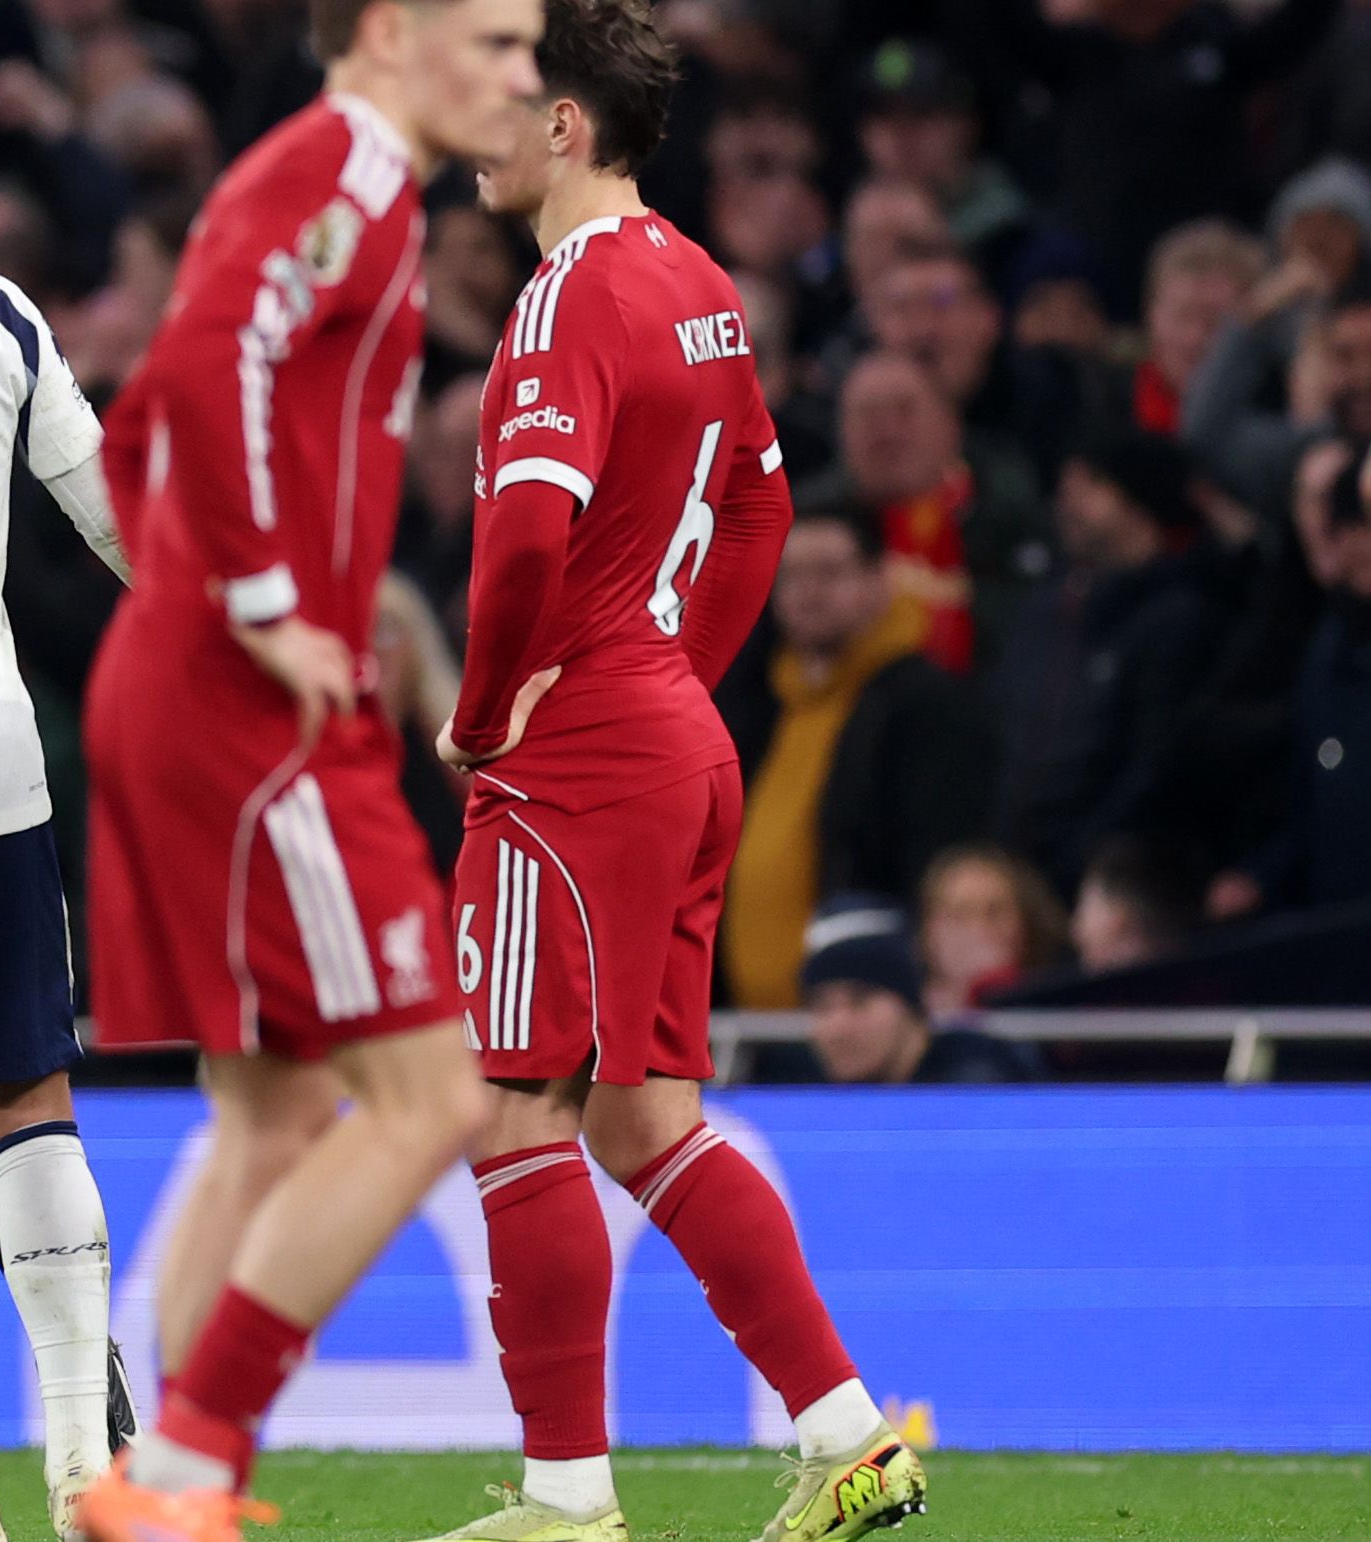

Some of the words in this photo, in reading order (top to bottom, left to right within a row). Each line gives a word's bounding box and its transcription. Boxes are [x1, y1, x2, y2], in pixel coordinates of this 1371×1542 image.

[498, 405, 575, 442] xpedia
[646, 420, 724, 637] 6
[458, 904, 483, 994] 6
[10, 1241, 108, 1265] SPURS
